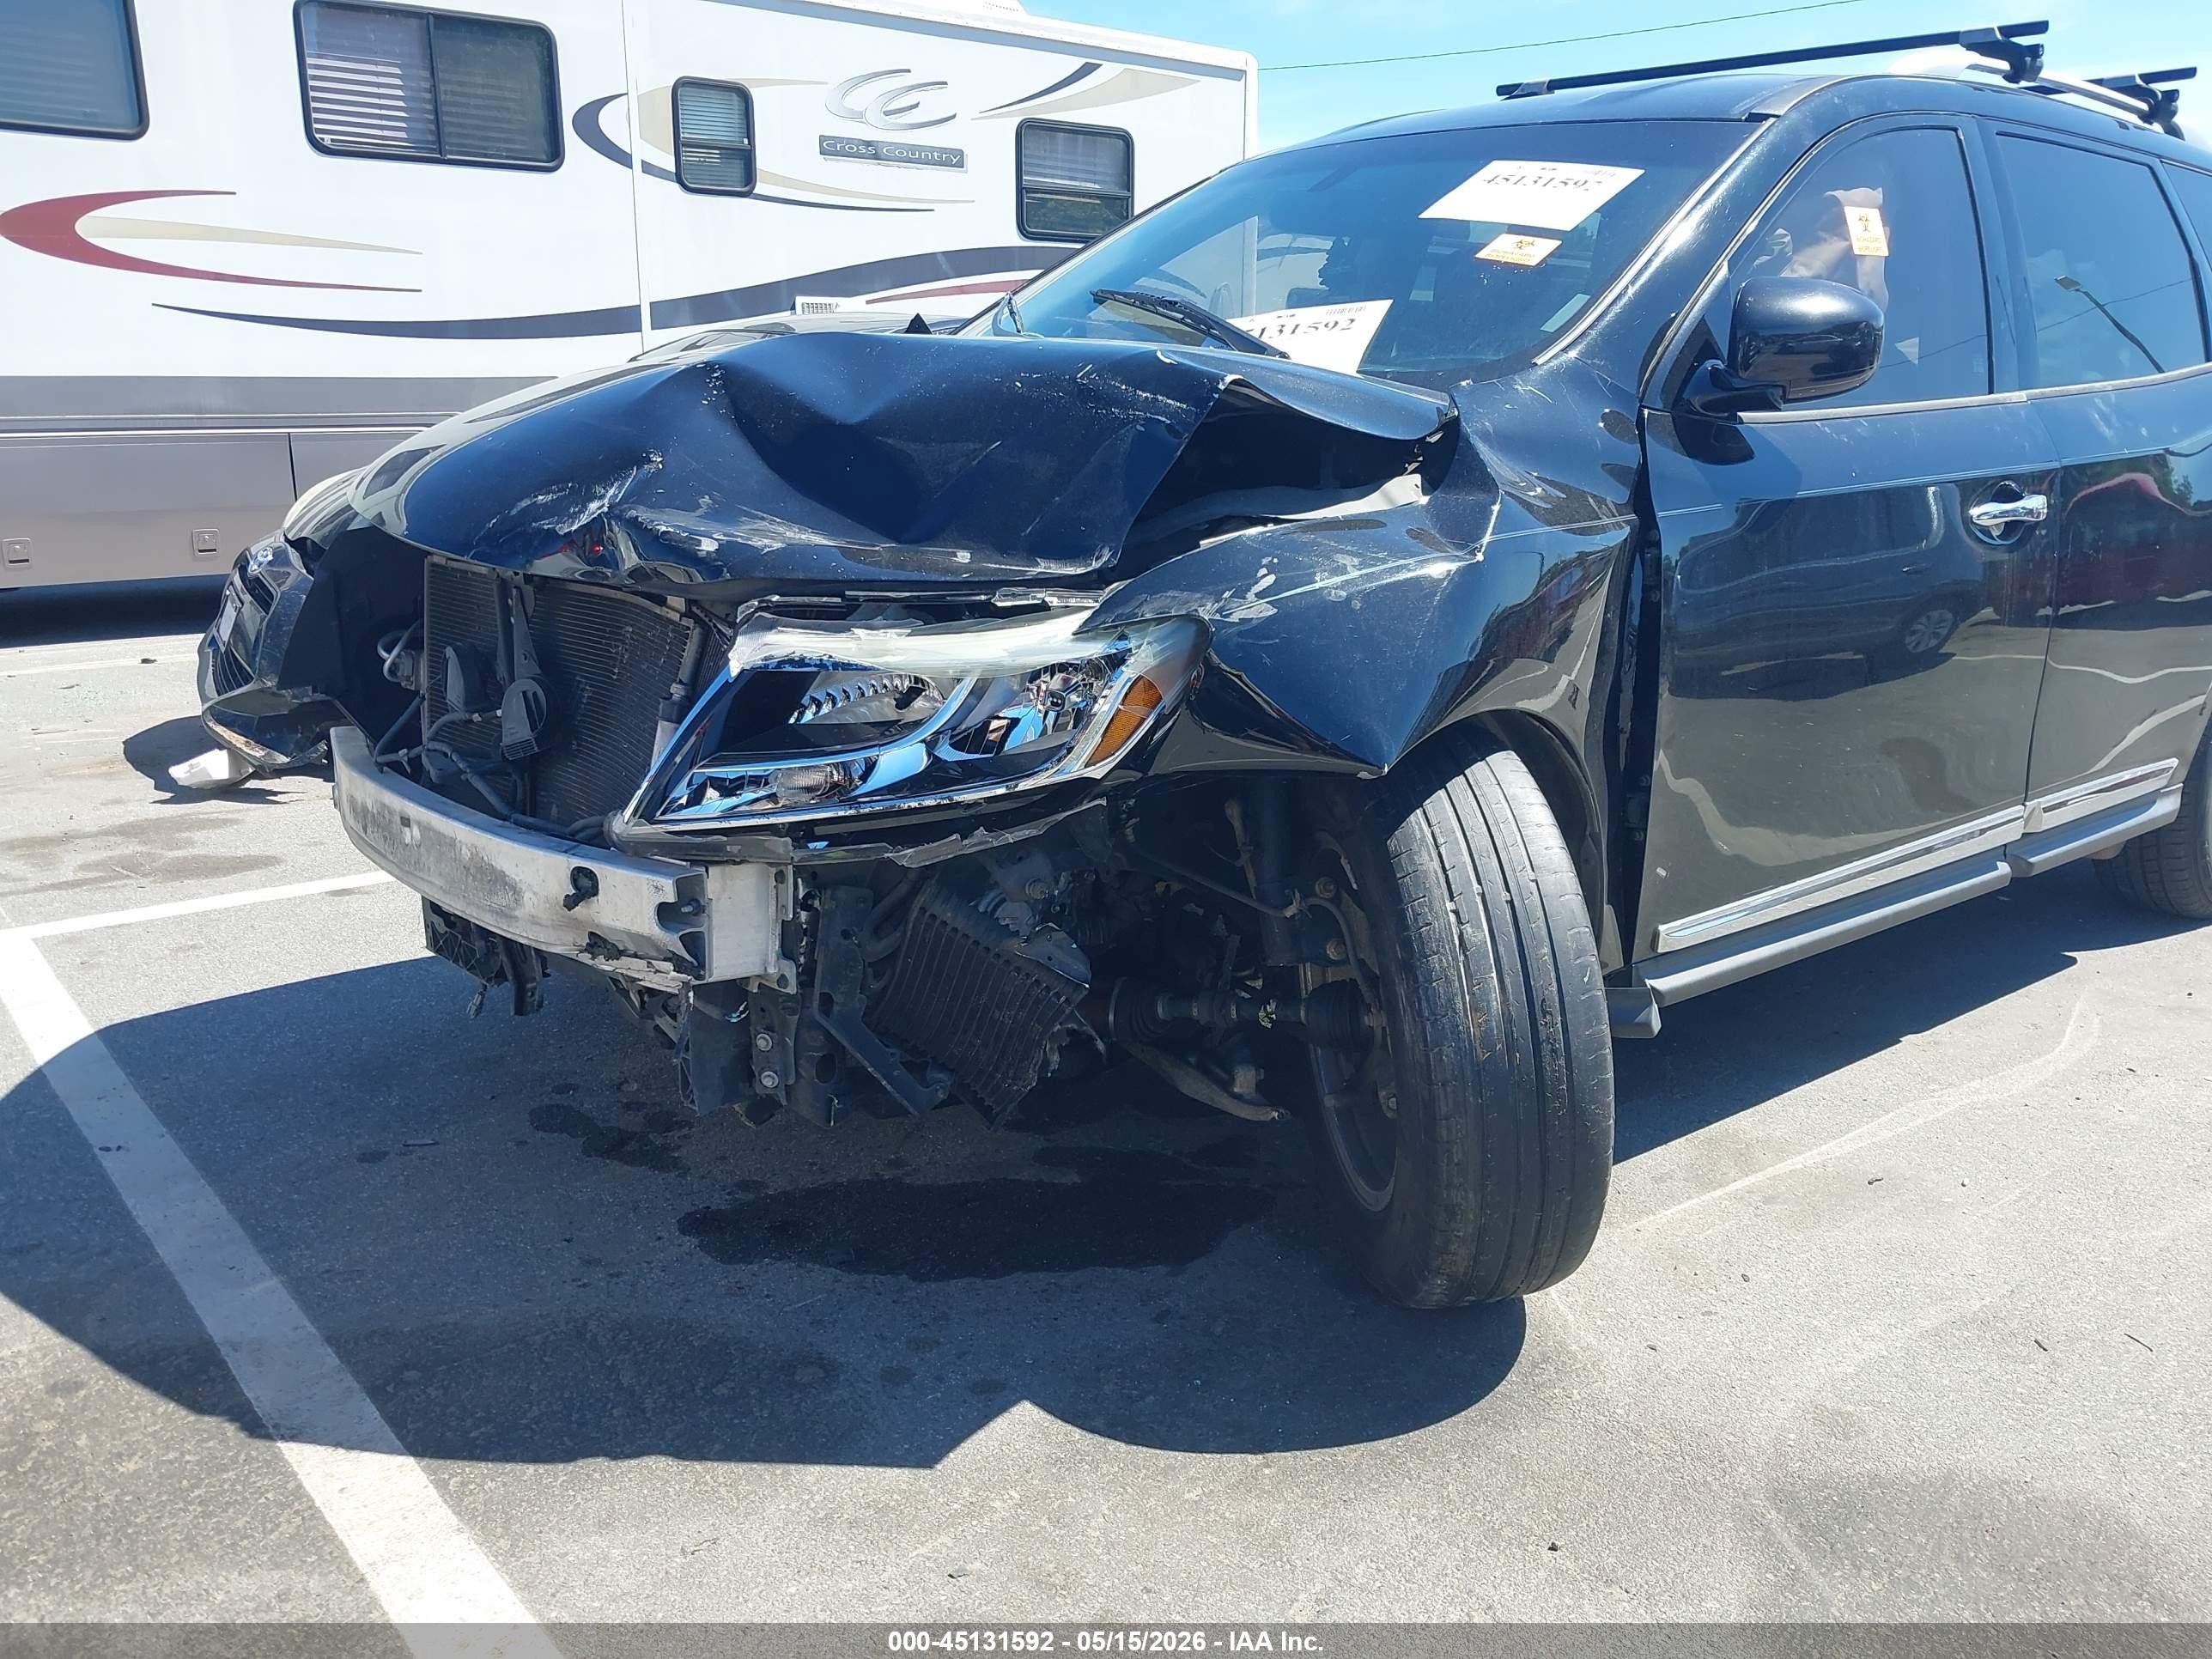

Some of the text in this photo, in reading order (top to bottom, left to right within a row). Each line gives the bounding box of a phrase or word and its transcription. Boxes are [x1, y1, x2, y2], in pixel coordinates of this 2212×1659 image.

[823, 140, 961, 165] Cross Country
[1245, 318, 1357, 339] 131592
